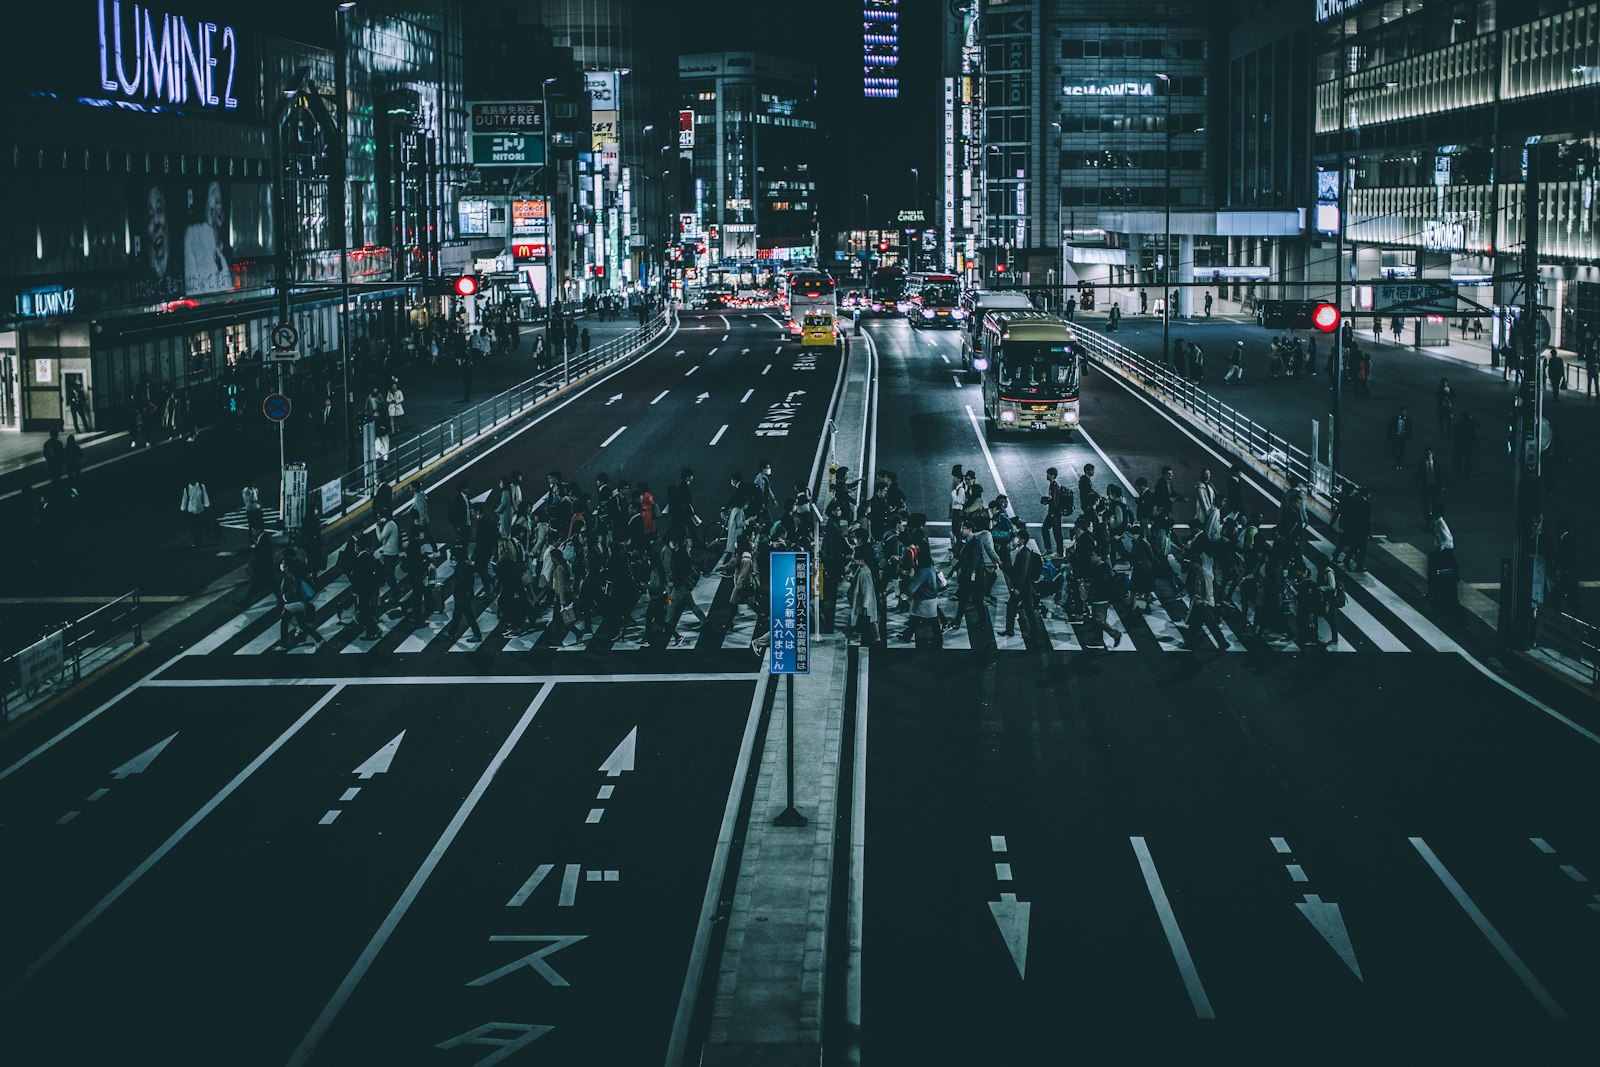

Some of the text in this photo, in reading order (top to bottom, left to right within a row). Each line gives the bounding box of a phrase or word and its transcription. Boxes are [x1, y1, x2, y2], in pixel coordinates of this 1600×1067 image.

[98, 0, 237, 107] LUMINE 2
[492, 138, 524, 151] ニトリ
[773, 619, 784, 670] 入れません
[784, 577, 795, 650] バスタ新宿へは
